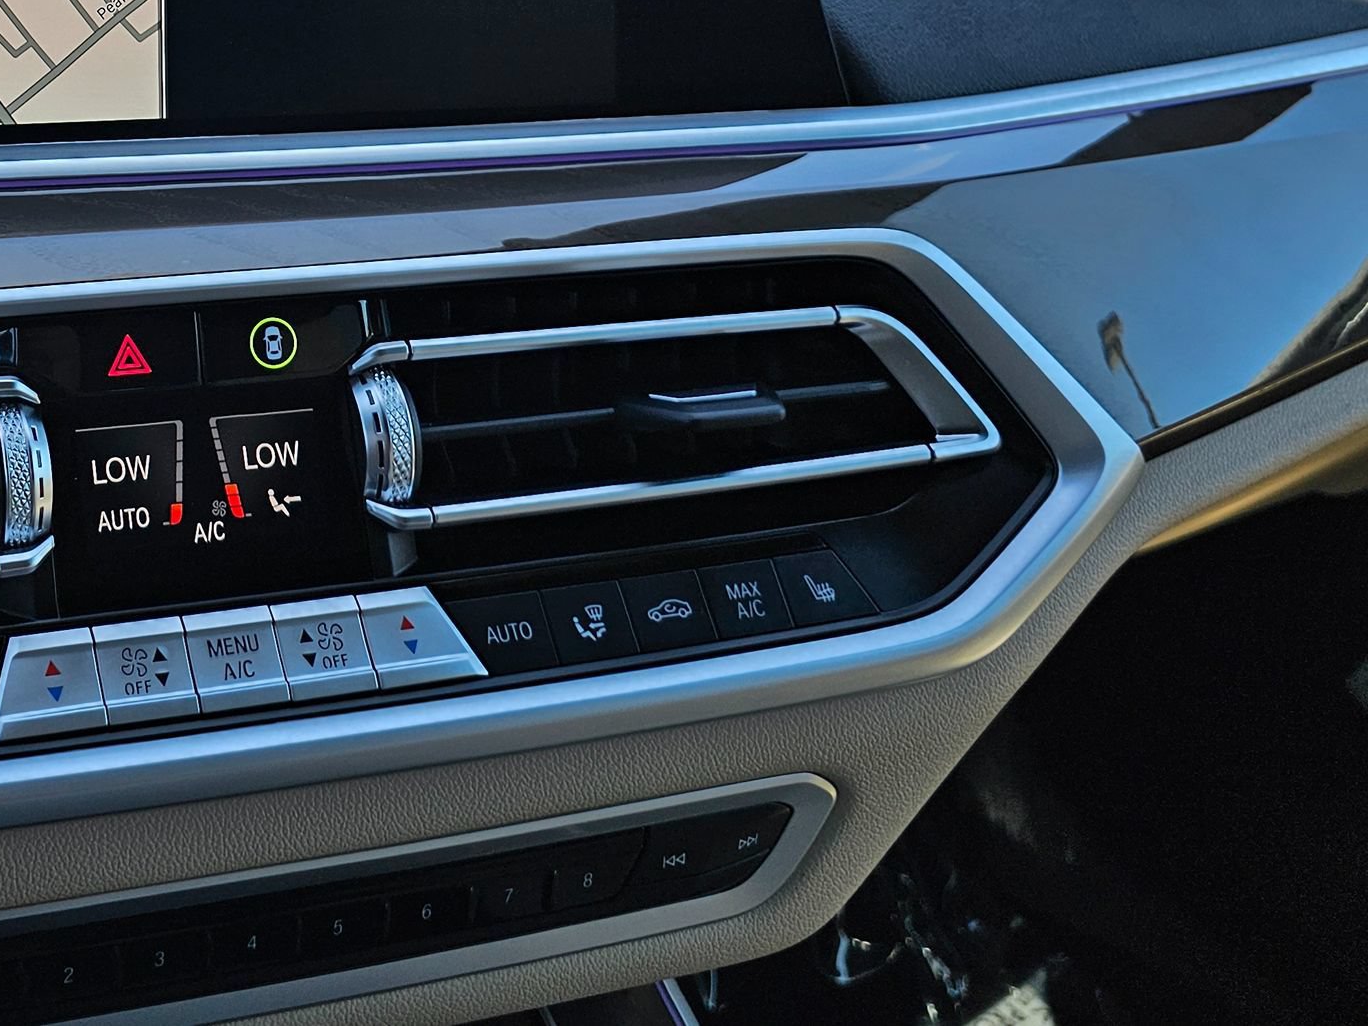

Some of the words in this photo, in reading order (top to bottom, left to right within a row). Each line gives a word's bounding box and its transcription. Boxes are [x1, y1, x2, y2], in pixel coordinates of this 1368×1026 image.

[242, 440, 299, 470] LOW
[92, 455, 150, 485] LOW
[98, 507, 150, 532] AUTO
[194, 521, 226, 544] A/C
[725, 581, 762, 600] MAX
[737, 599, 766, 620] A/C
[487, 621, 533, 644] AUTO
[207, 633, 259, 658] MENU
[224, 659, 256, 681] A/C
[322, 653, 348, 669] OFF
[125, 679, 152, 696] OFF
[583, 872, 593, 888] 8
[505, 888, 514, 903] 7
[421, 903, 432, 921] 6
[333, 919, 343, 937] 5
[247, 934, 257, 950] 4
[154, 950, 165, 967] 3
[63, 966, 74, 985] 2
